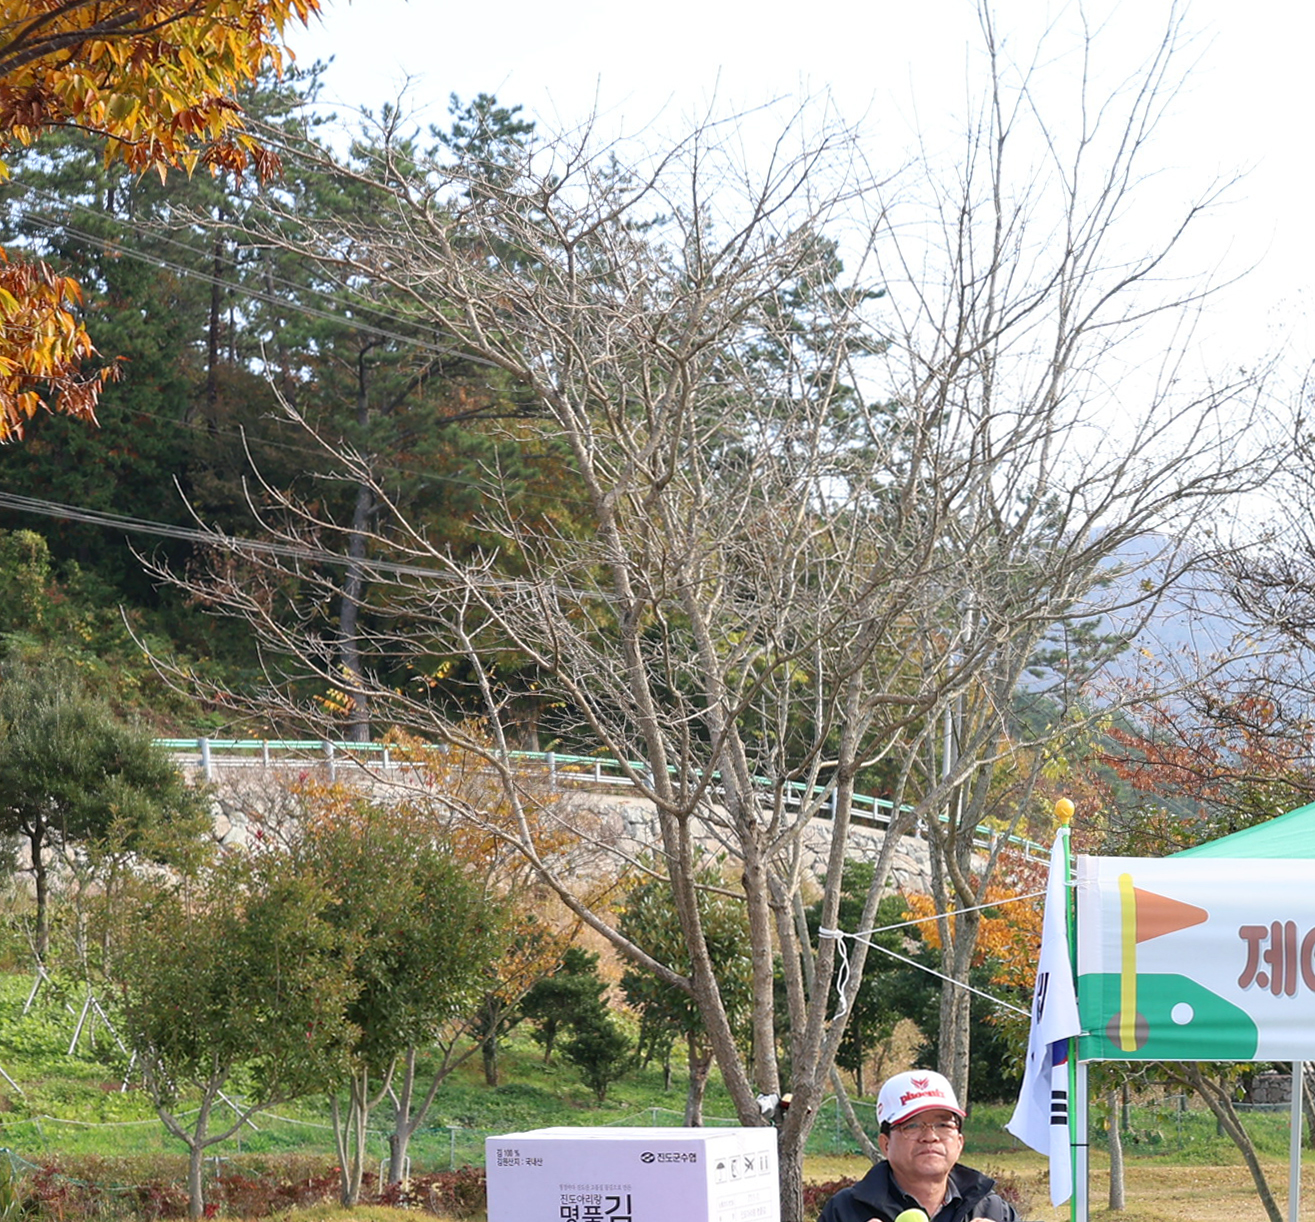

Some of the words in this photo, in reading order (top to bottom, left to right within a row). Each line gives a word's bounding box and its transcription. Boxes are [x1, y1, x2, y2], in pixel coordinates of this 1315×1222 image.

[899, 1089, 946, 1107] phoenix
[656, 1152, 697, 1164] 진도군수협
[559, 1193, 602, 1205] 진도아리랑
